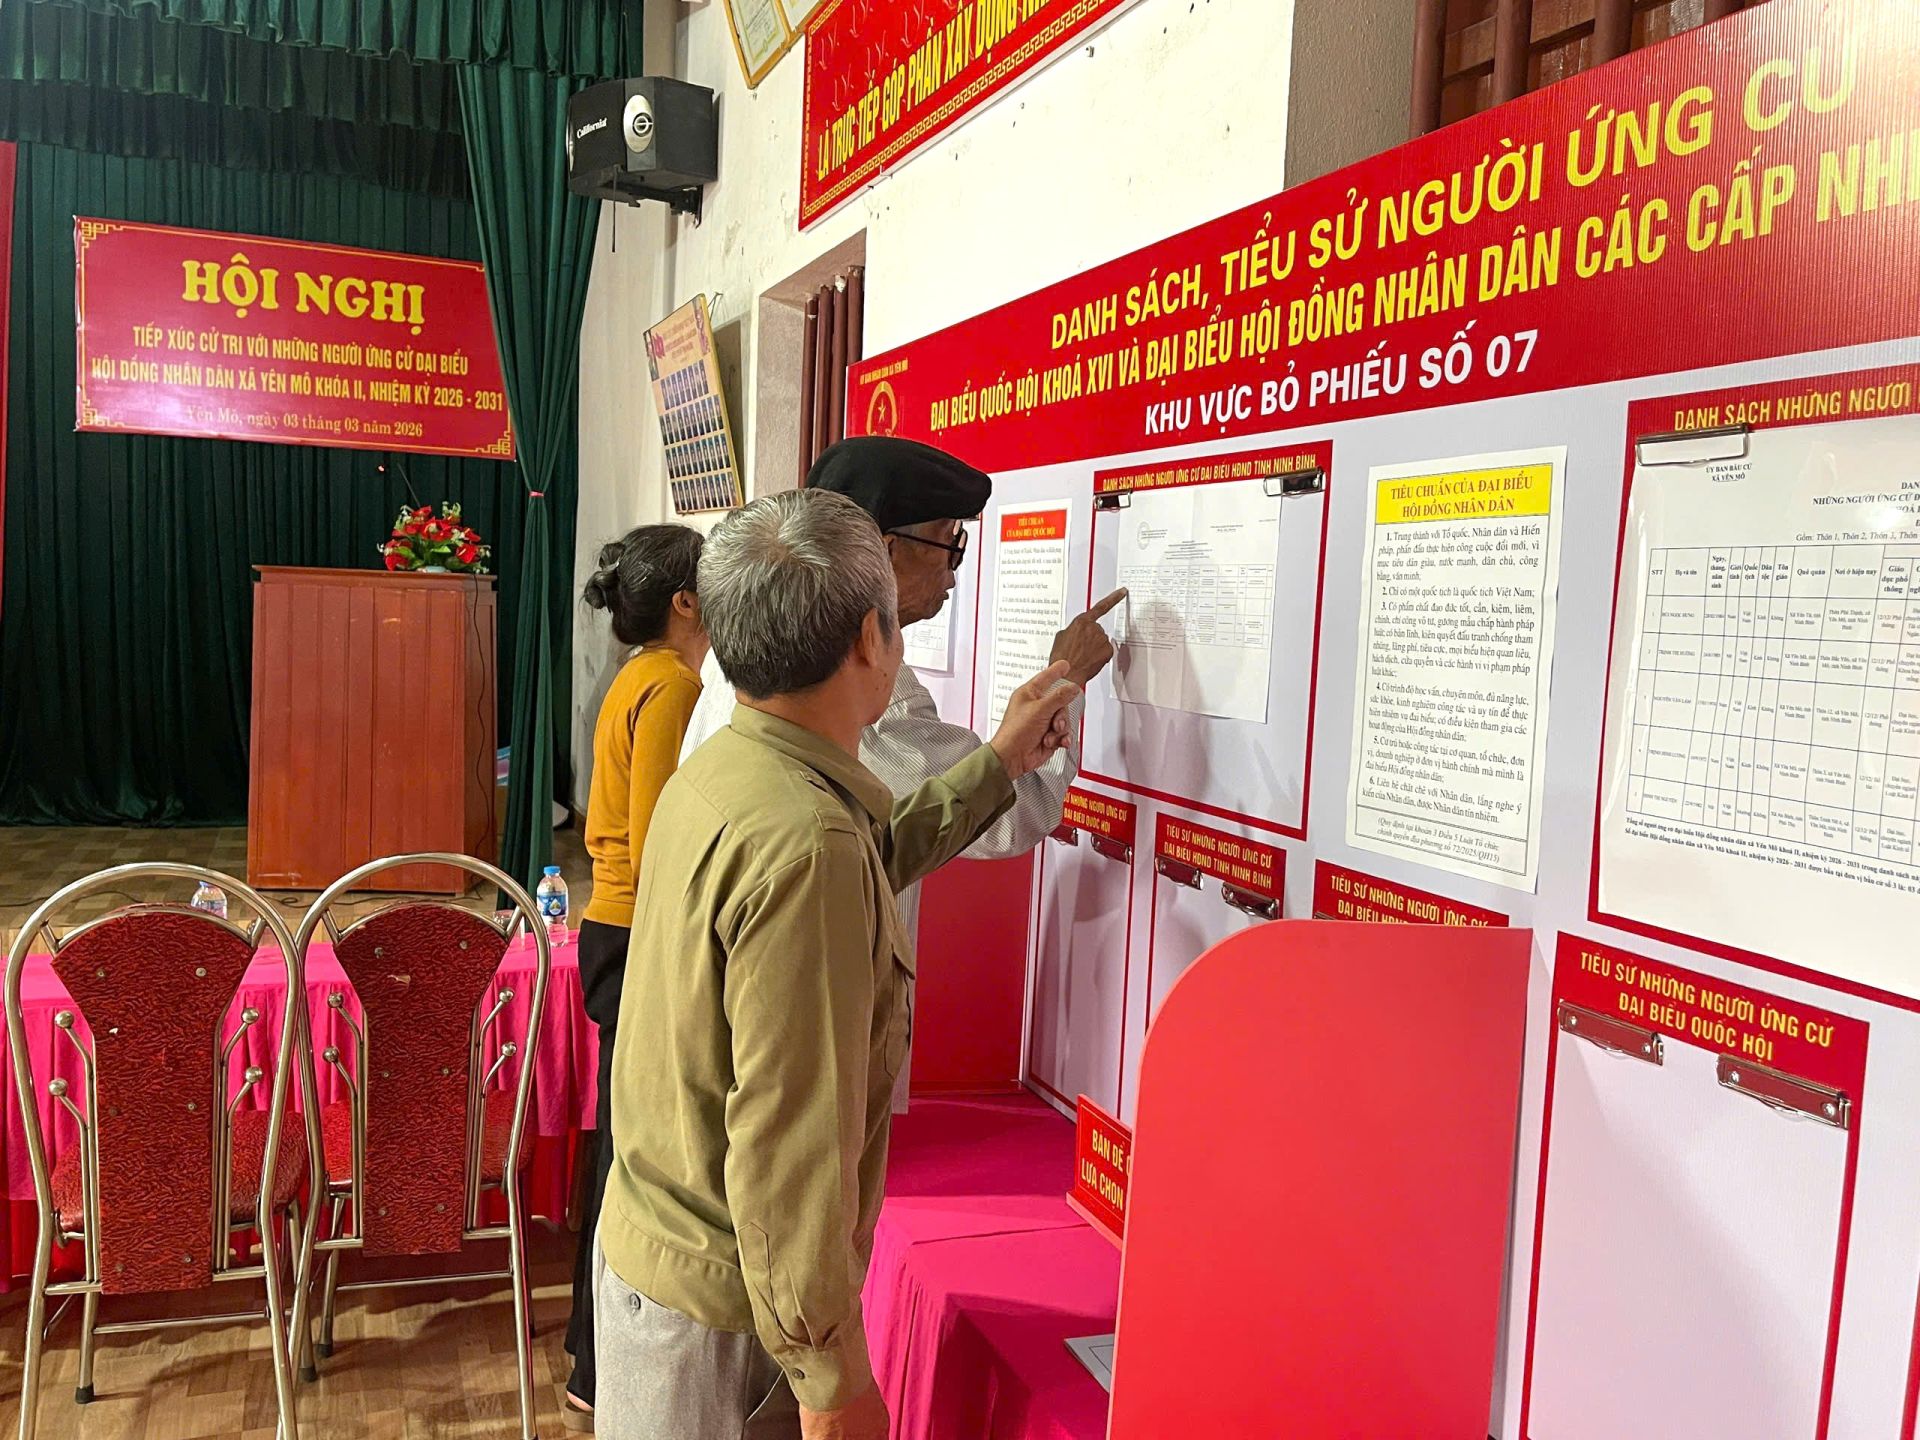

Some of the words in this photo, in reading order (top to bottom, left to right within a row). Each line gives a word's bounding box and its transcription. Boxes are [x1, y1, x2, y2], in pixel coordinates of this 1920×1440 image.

[818, 120, 829, 182] LÀ
[832, 103, 856, 173] TRỰC
[858, 69, 881, 150] TIẾP
[882, 58, 905, 132] GÓP
[907, 17, 943, 112] PHẦN
[945, 1, 974, 84] XÂY
[1052, 294, 1117, 350] DANH
[1125, 264, 1209, 327] SÁCH,
[1220, 211, 1296, 296] TIỂU
[1308, 187, 1369, 269] SỬ
[1377, 137, 1544, 249] NGƯỜI
[1566, 86, 1713, 187] ỨNG
[182, 252, 280, 319] HỘI
[294, 271, 425, 336] NGHỊ
[930, 398, 949, 437] ĐẠI
[951, 379, 977, 427] BIỂU
[979, 370, 1013, 423] QUỐC
[1015, 368, 1039, 417] HỘI
[1042, 353, 1082, 405] KHOÁ
[1086, 352, 1114, 395] XVI
[1118, 336, 1140, 387] VÀ
[1145, 334, 1179, 387] ĐẠI
[1184, 304, 1234, 372] BIỂU
[1240, 298, 1281, 364] HỘI
[1287, 276, 1365, 347] ĐỒNG
[1373, 250, 1468, 327] NHÂN
[1478, 224, 1562, 303] DÂN
[1575, 193, 1670, 279] CÁC
[1686, 145, 1797, 253] CẤP
[133, 322, 163, 347] TIẾP
[168, 326, 195, 351] XÚC
[200, 326, 219, 353] CỬ
[222, 334, 243, 355] TRI
[247, 333, 268, 358] VỚI
[272, 336, 318, 362] NHỮNG
[323, 341, 362, 366] NGƯỜI
[366, 343, 392, 368] ỨNG
[395, 345, 414, 371] CỬ
[416, 352, 437, 377] ĐẠI
[440, 348, 468, 376] BIỂU
[1145, 399, 1191, 435] KHU
[1200, 383, 1252, 433] VỰC
[1260, 360, 1299, 416] BỎ
[1309, 341, 1408, 407] PHIẾU
[1419, 319, 1478, 389] SỐ
[1486, 329, 1539, 378] 07
[92, 354, 116, 384] HỘI
[120, 354, 158, 383] ĐỒNG
[163, 361, 201, 387] NHÂN
[206, 364, 234, 389] DÂN
[239, 367, 257, 391] XÃ
[261, 368, 286, 393] YÊN
[290, 371, 312, 395] MÔ
[316, 374, 349, 398] KHÓA
[354, 379, 366, 402] II,
[370, 379, 411, 407] NHIỆM
[414, 381, 430, 405] KỲ
[434, 387, 464, 408] 2026
[475, 391, 503, 411] 2031
[1675, 406, 1719, 431] DANH
[1724, 397, 1771, 425] SÁCH
[1776, 388, 1841, 421] NHỮNG
[218, 407, 242, 424] Mô,
[247, 412, 278, 428] ngày
[283, 413, 299, 427] 03
[302, 415, 341, 434] tháng
[344, 418, 359, 432] 03
[363, 419, 391, 435] năm
[394, 422, 423, 437] 2026
[1391, 484, 1414, 500] TIÊU
[1416, 478, 1452, 498] CHUẨN
[1453, 477, 1474, 494] CỦA
[1478, 478, 1501, 495] ĐẠI
[1503, 470, 1534, 491] BIỂU
[1402, 502, 1421, 521] HỘI
[1423, 498, 1451, 516] ĐỒNG
[1453, 497, 1485, 514] NHÂN
[1488, 495, 1515, 512] DÂN
[1581, 950, 1611, 977] TIỂU
[1615, 959, 1638, 985] SỬ
[1639, 969, 1696, 1005] NHỮNG
[1700, 989, 1755, 1024] NGƯỜI
[1760, 1002, 1799, 1038] ỨNG
[1805, 1017, 1835, 1048] CỬ
[1619, 992, 1645, 1019] ĐẠI
[1649, 1001, 1686, 1031] BIỂU
[1691, 1016, 1737, 1048] QUỐC
[1742, 1032, 1774, 1063] HỘI
[1081, 1157, 1098, 1191] LỰA
[1099, 1171, 1124, 1211] CHỌN
